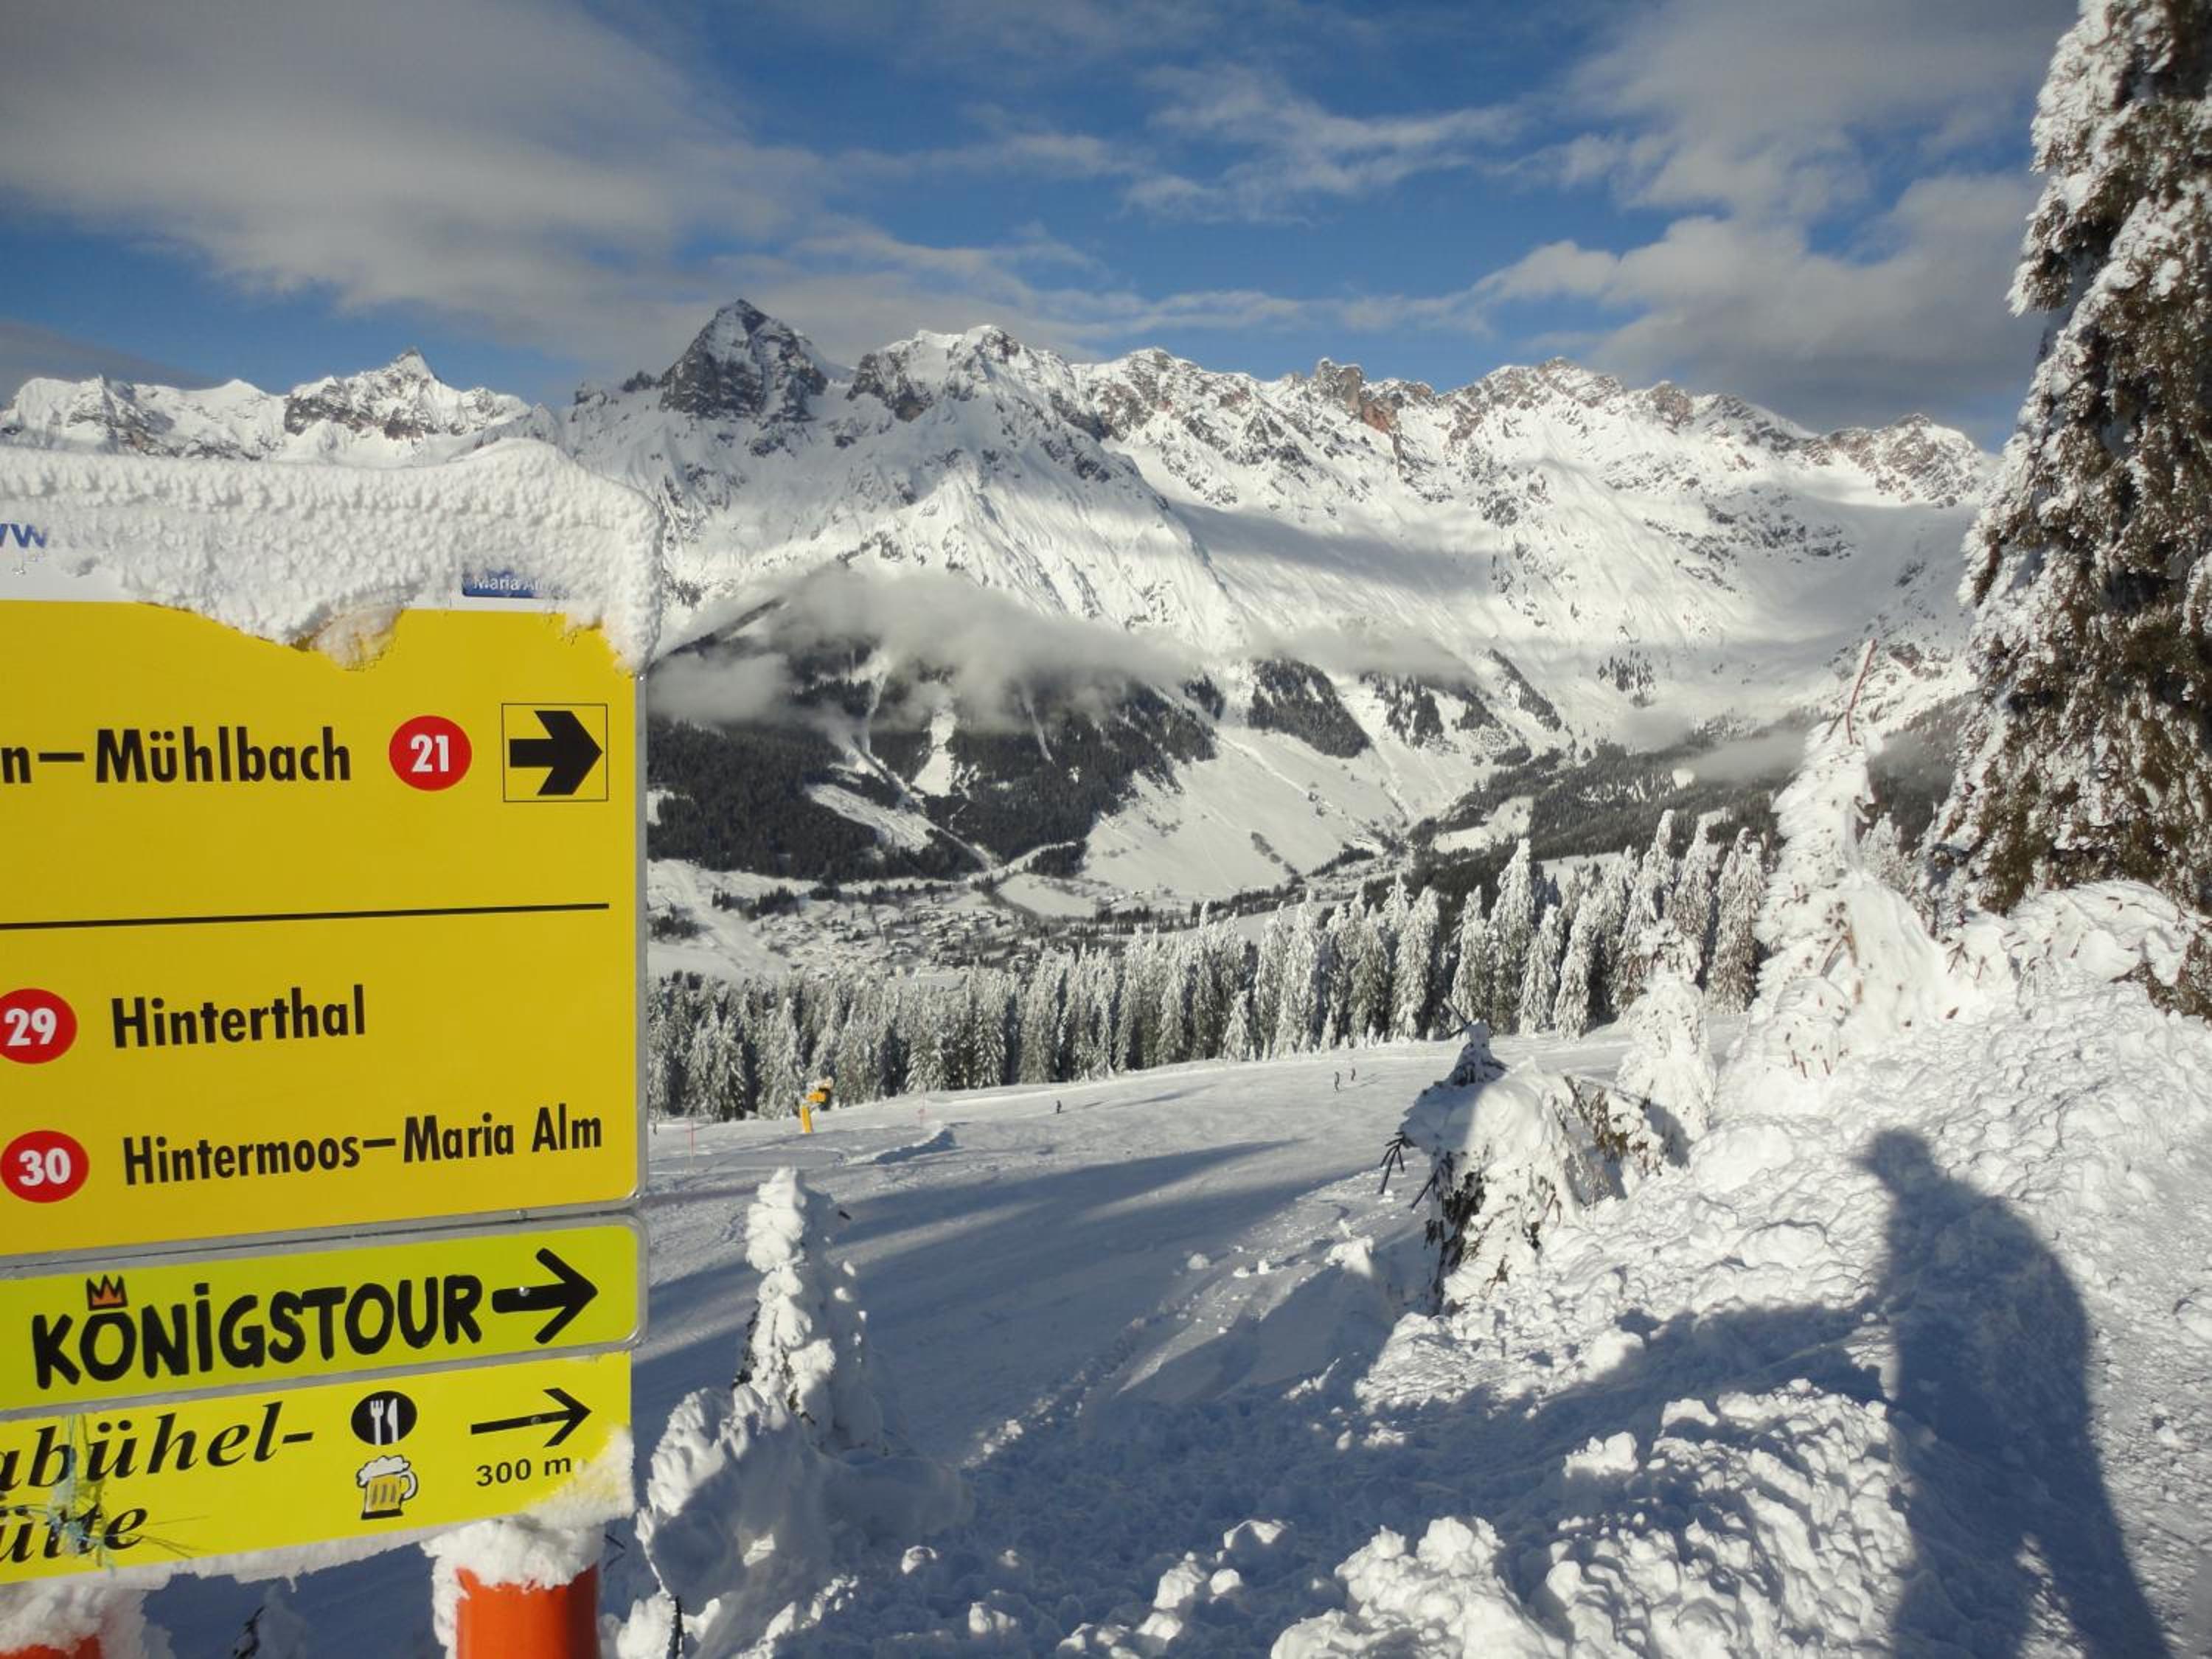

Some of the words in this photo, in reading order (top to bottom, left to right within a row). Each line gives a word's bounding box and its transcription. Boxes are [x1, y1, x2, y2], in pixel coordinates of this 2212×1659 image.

[473, 575, 520, 591] Maria
[411, 734, 449, 772] 21
[4, 1008, 57, 1046] 29
[111, 984, 366, 1048] Hinterthal
[18, 1147, 71, 1186] 30
[532, 1103, 602, 1152] Alm
[476, 1458, 532, 1487] 300
[544, 1457, 571, 1476] m
